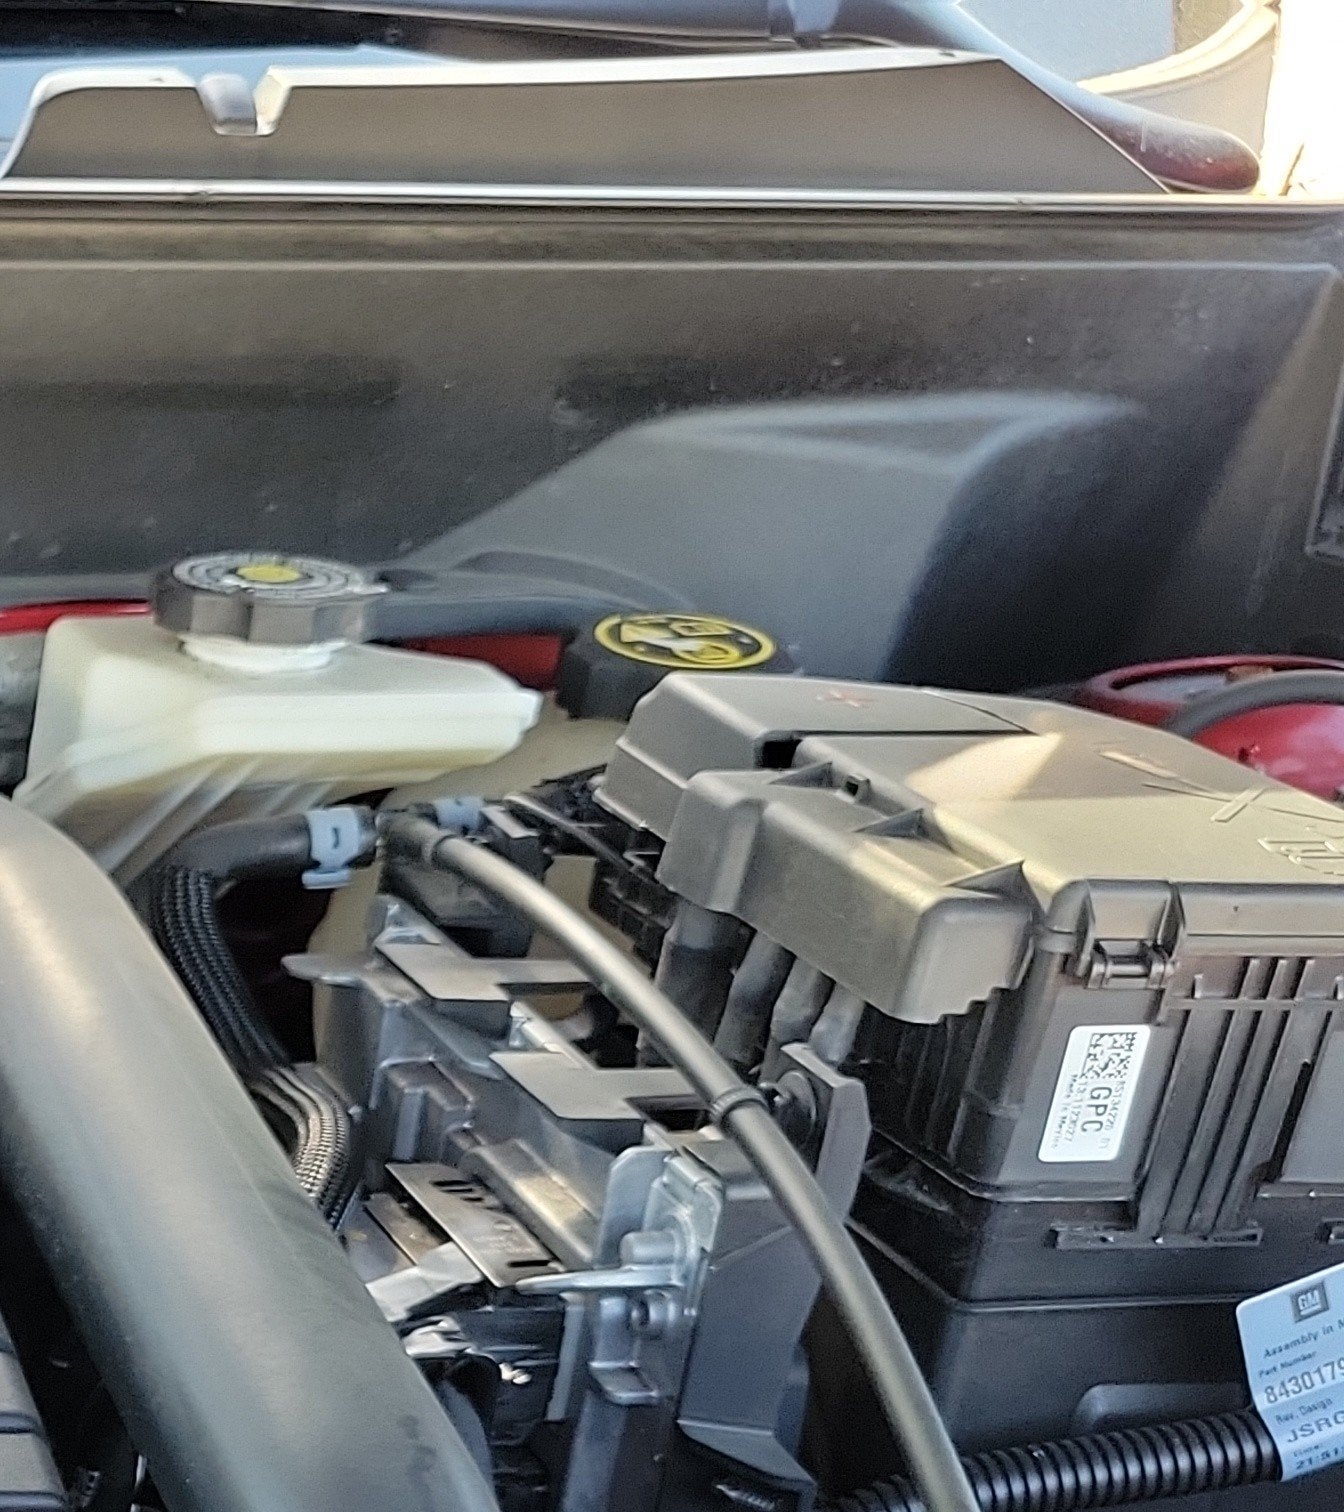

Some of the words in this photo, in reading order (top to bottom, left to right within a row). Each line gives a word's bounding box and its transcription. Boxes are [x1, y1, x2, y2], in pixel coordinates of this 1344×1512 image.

[1081, 1086, 1113, 1132] GPC
[1298, 1289, 1322, 1315] GM
[1263, 1331, 1319, 1359] Assembly
